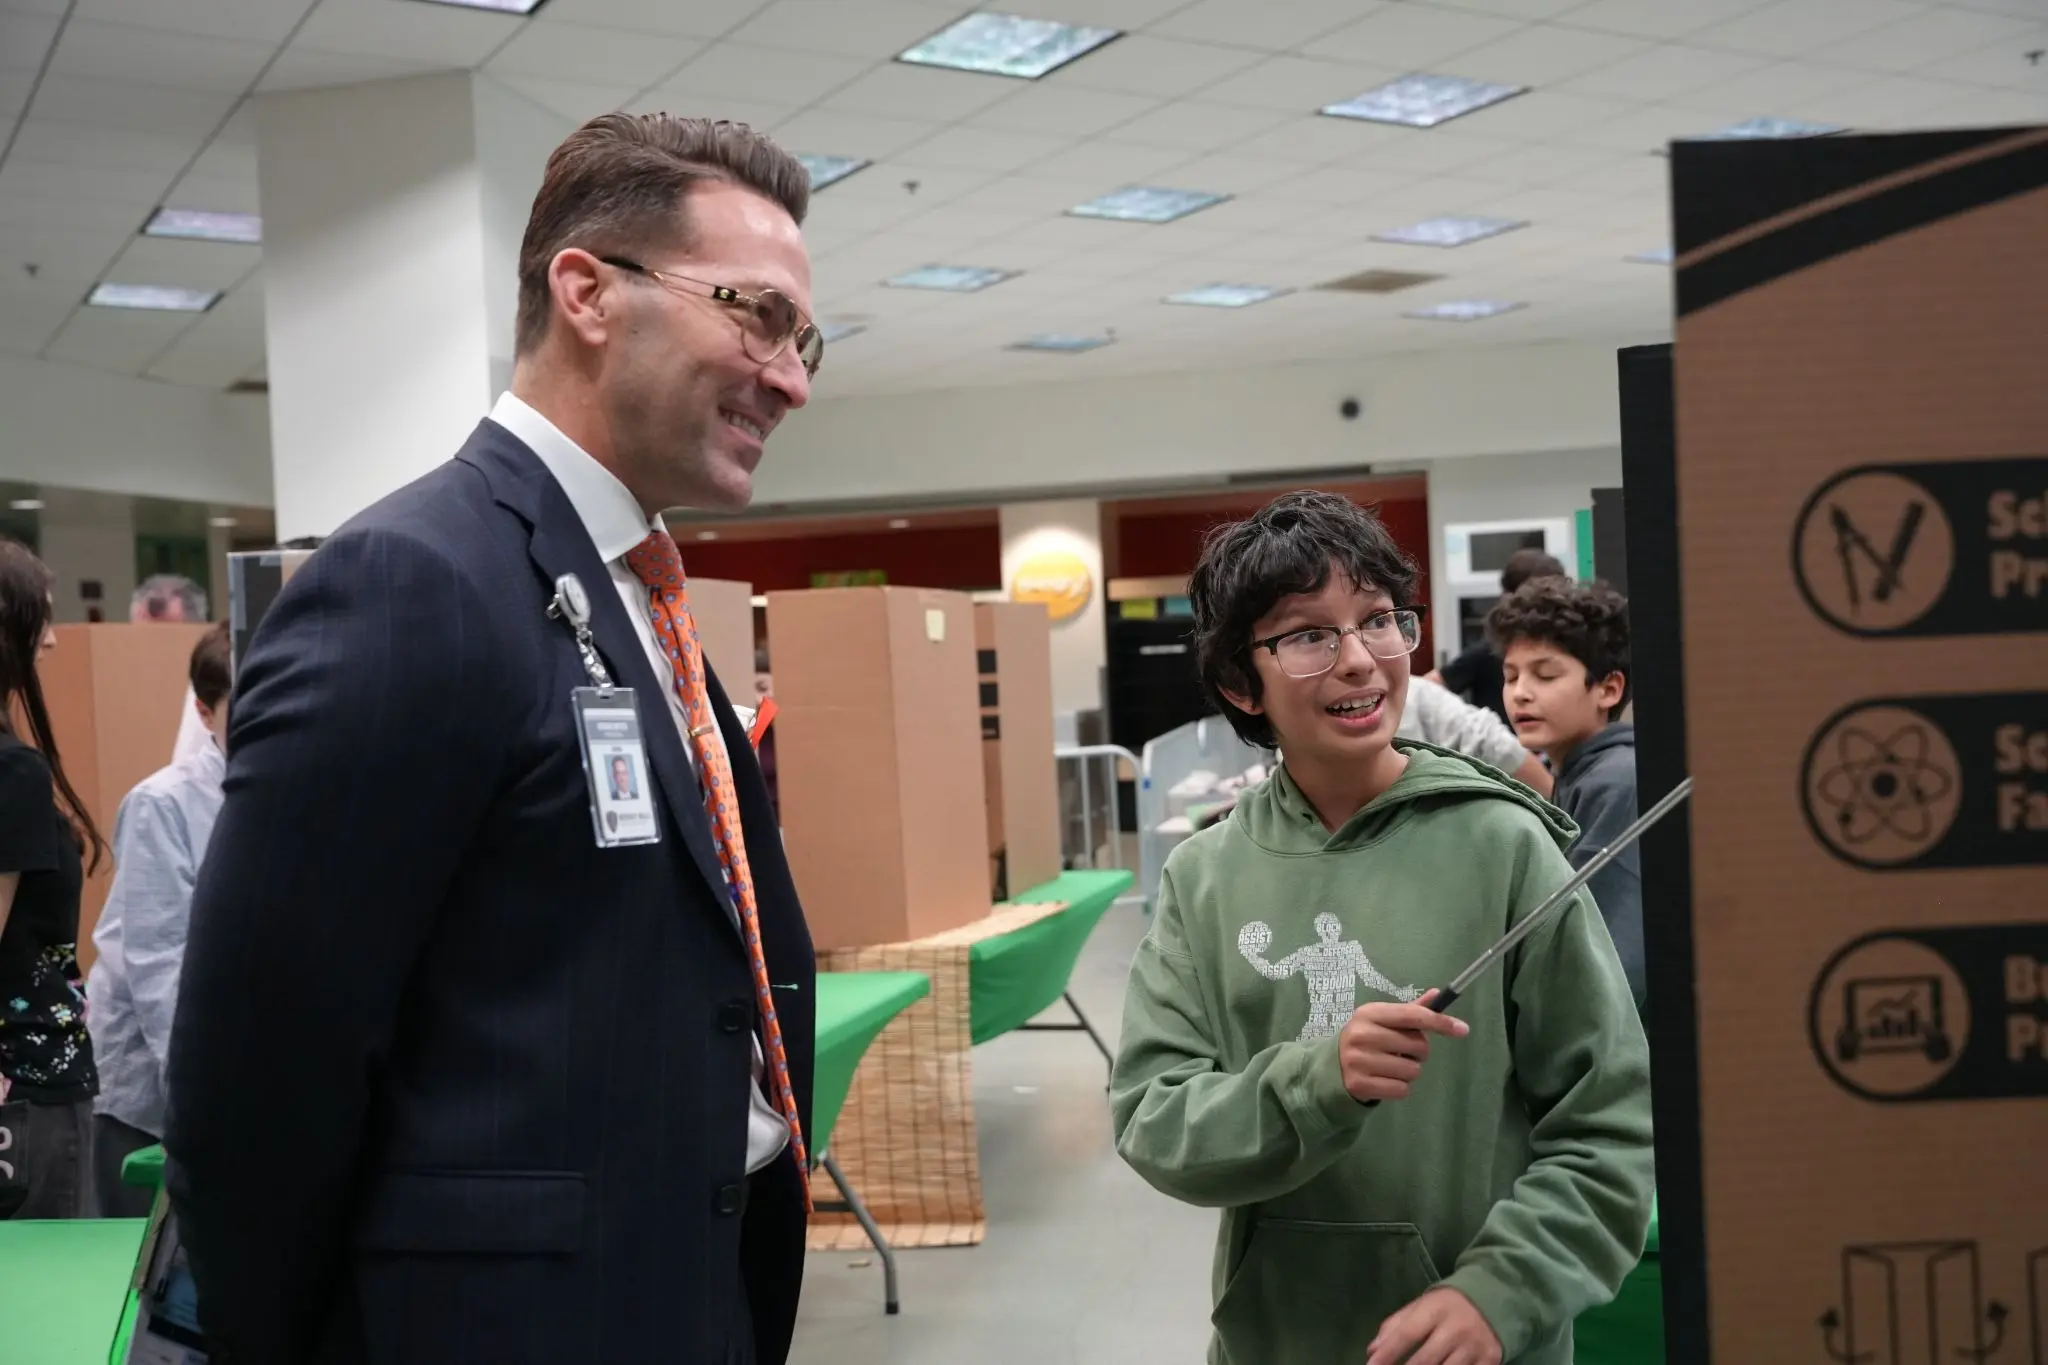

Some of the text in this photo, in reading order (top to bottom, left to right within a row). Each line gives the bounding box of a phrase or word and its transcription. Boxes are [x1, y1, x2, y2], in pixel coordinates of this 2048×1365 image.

[1238, 931, 1273, 945] ASSIST
[1323, 945, 1353, 957] DEFENSE
[1262, 964, 1293, 977] ASSIST
[1308, 975, 1355, 991] REBOUND
[1310, 991, 1355, 1003] SLAM DUNK
[1309, 1013, 1328, 1024] FREE
